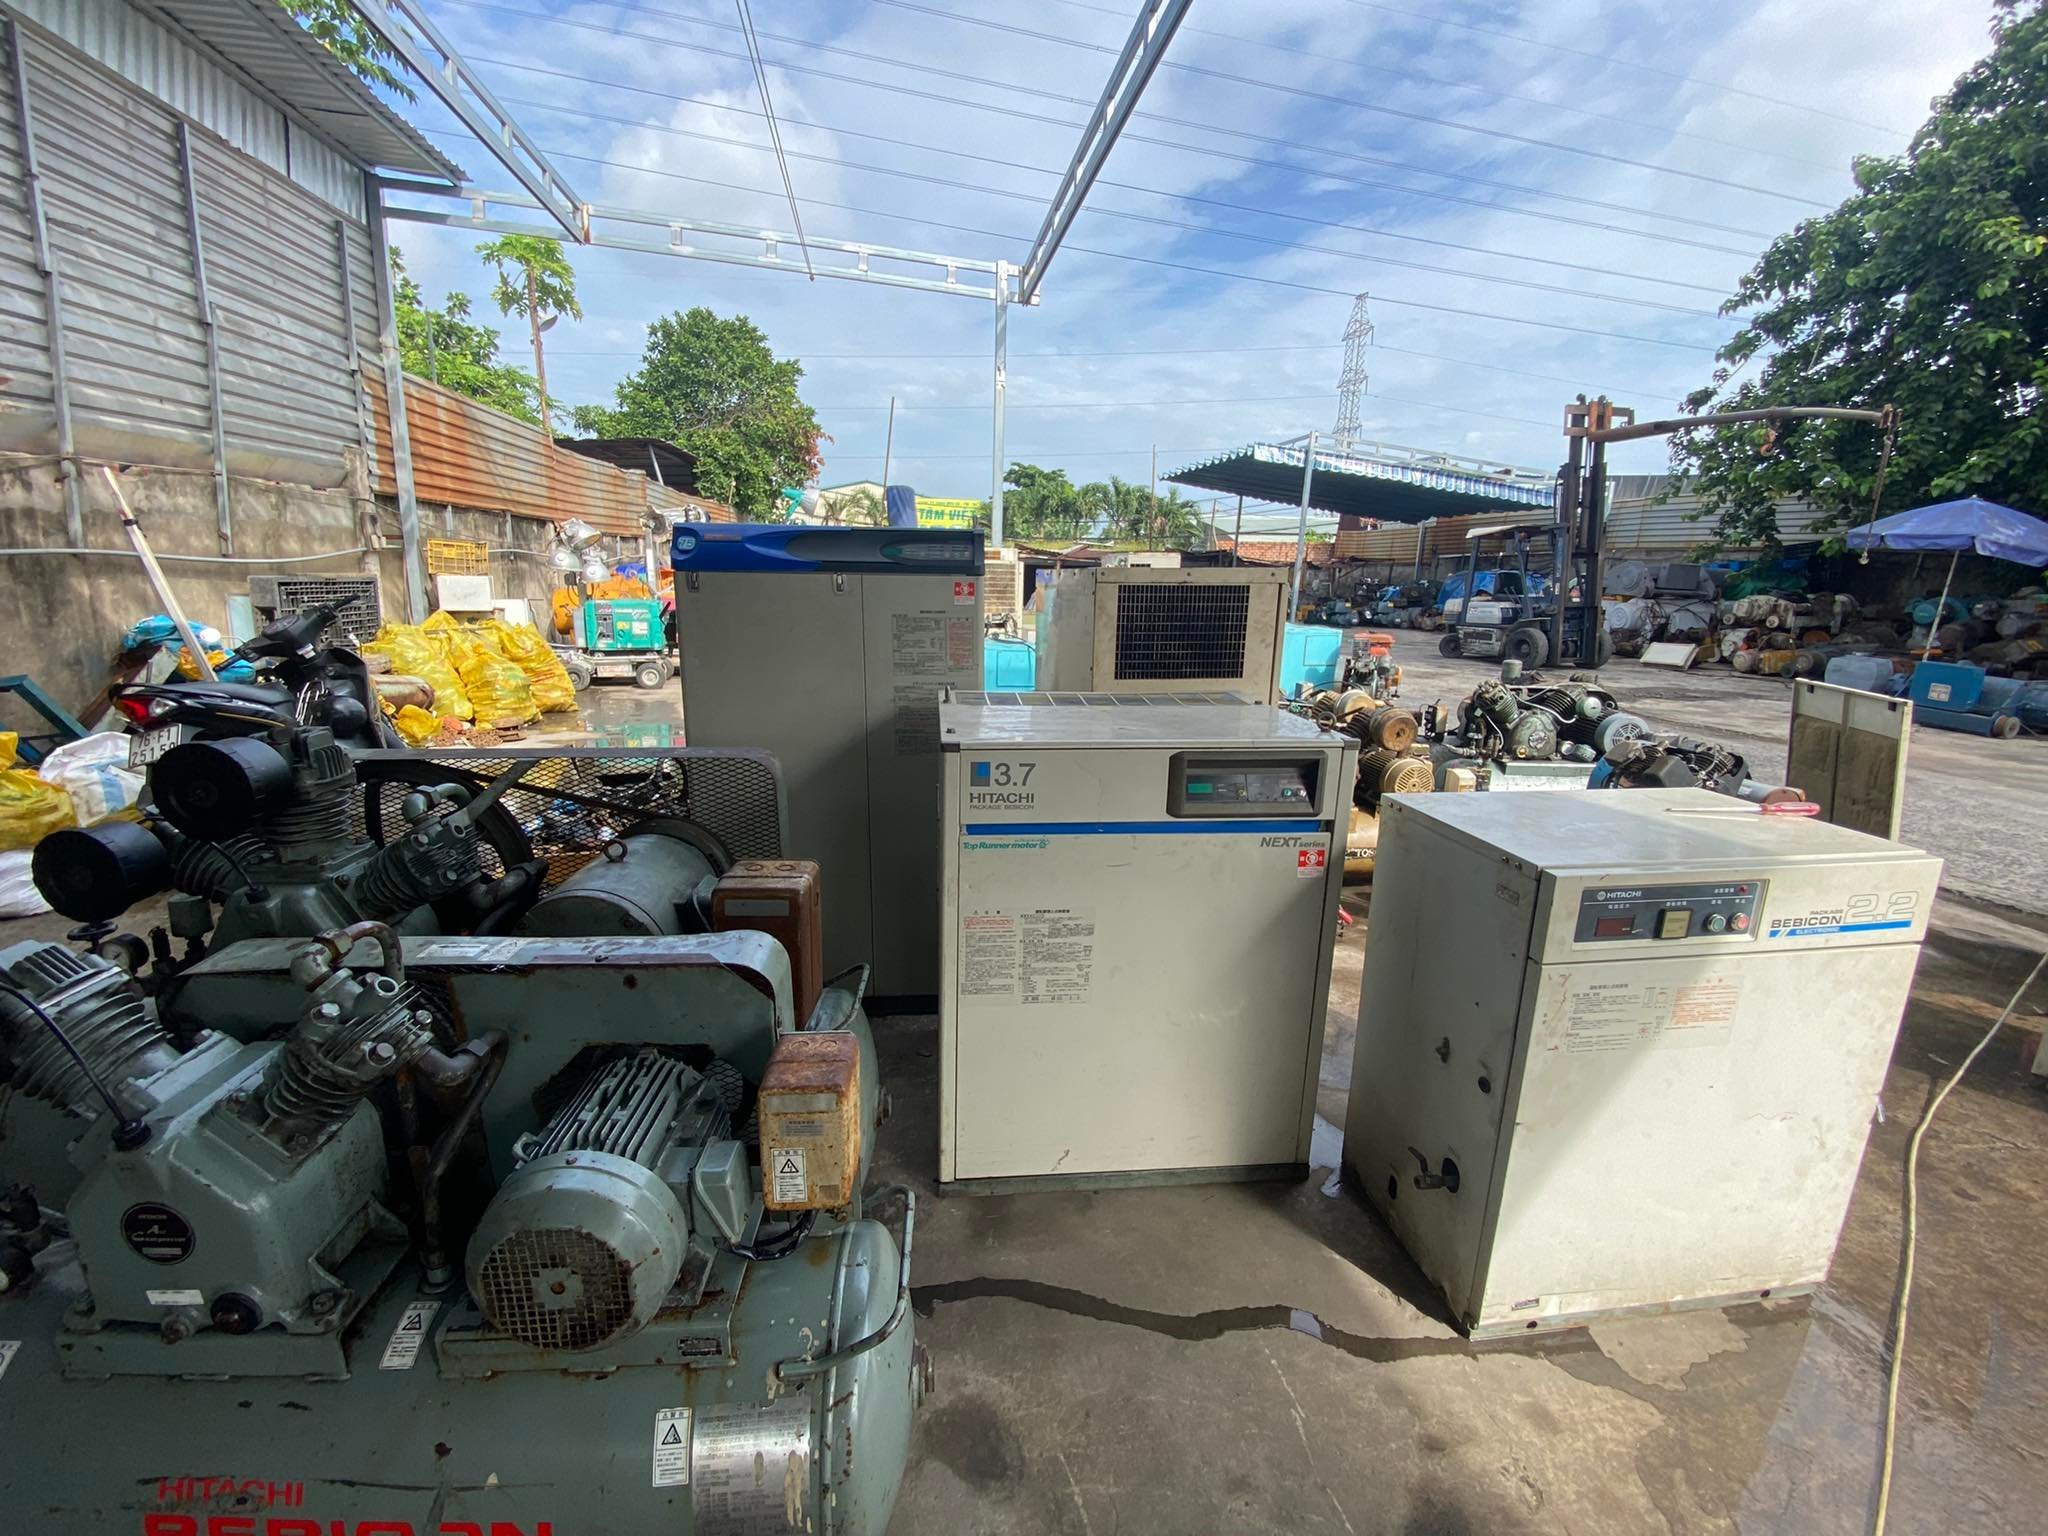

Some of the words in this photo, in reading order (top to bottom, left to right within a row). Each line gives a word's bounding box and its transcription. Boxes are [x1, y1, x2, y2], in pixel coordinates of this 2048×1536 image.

[993, 762, 1037, 787] 3.7
[969, 792, 1035, 804] HITACHI
[1606, 891, 1642, 899] HITACHI
[1843, 890, 1920, 924] 2.2
[1770, 915, 1843, 929] BEBICON
[158, 1476, 305, 1507] HITACHI
